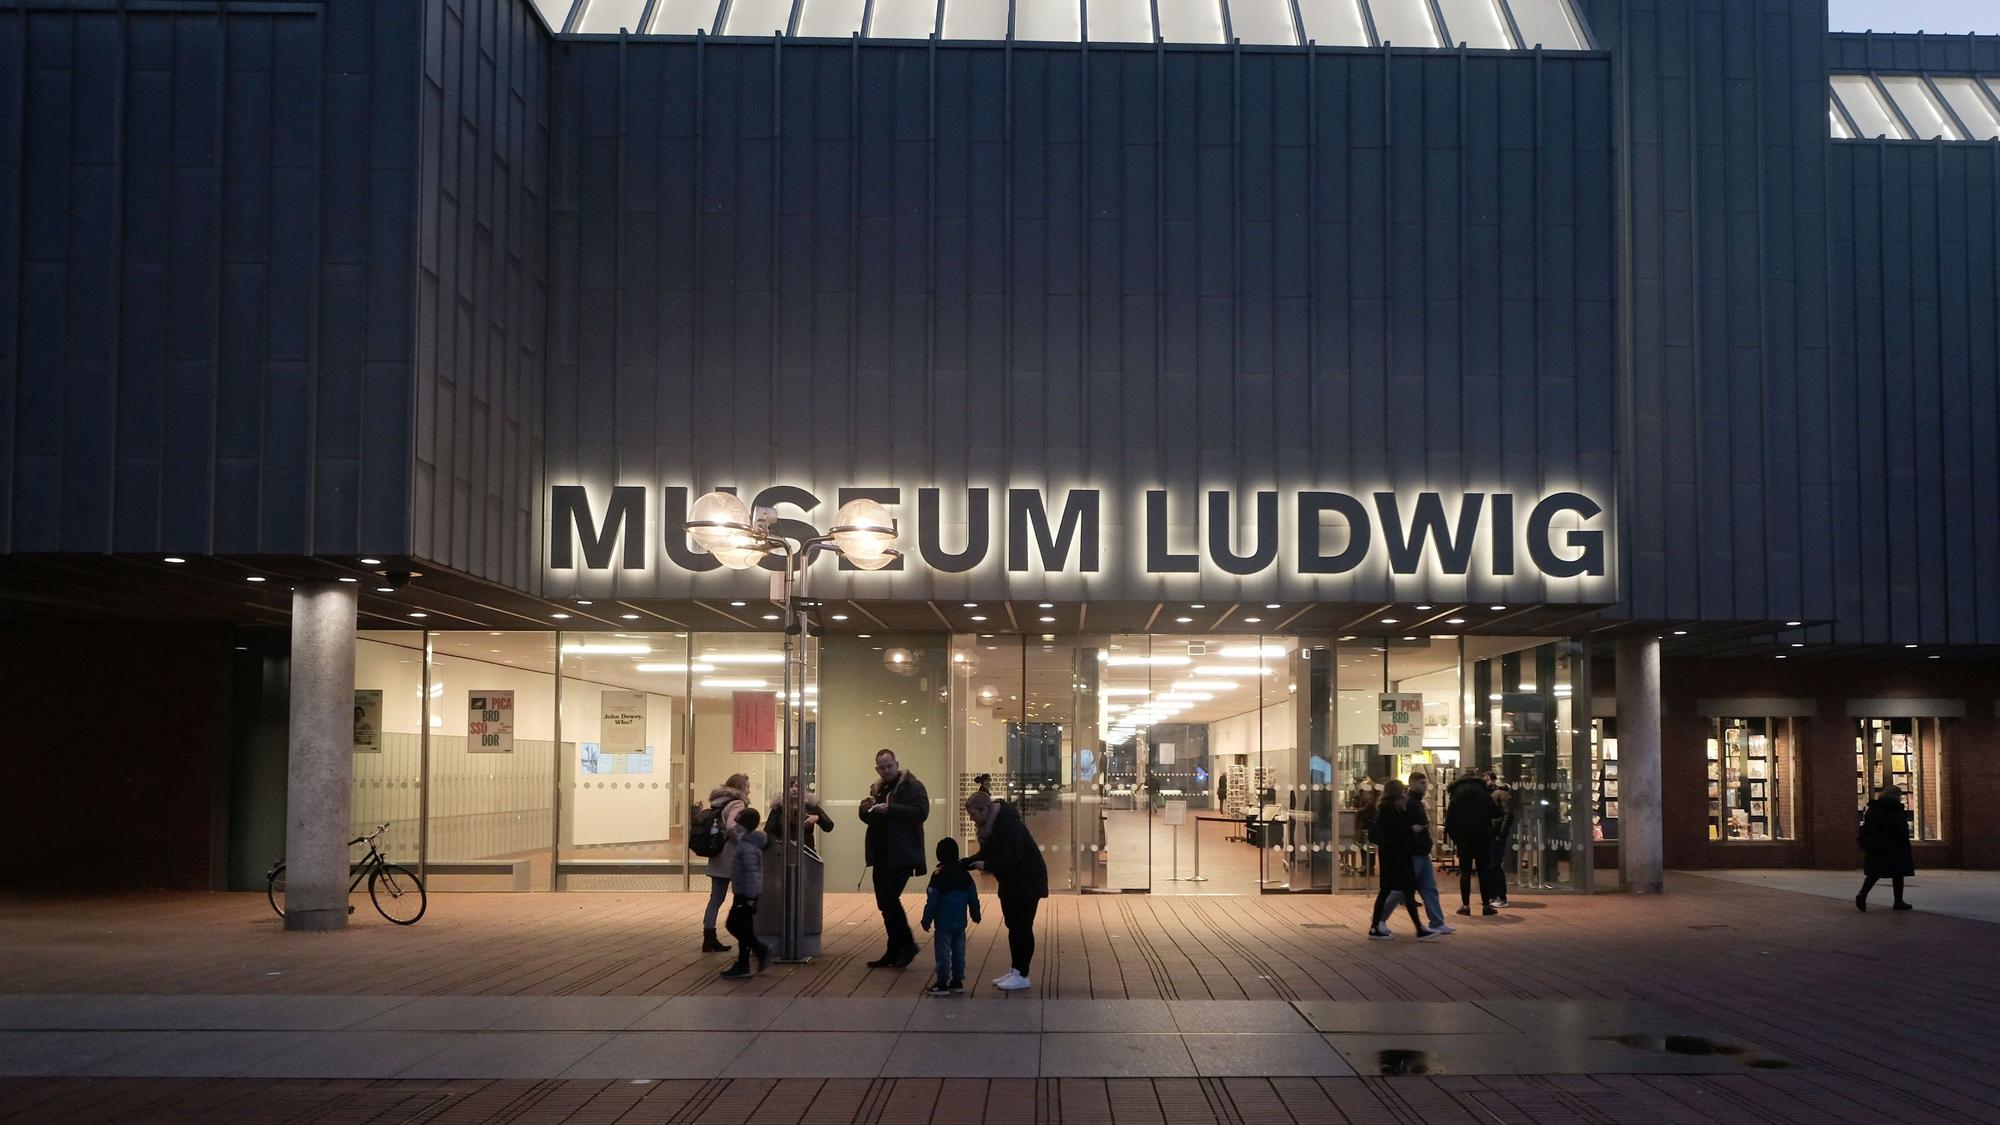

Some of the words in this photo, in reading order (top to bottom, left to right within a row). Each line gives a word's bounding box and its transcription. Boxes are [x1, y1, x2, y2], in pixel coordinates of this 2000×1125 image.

[551, 484, 1100, 573] MUSEUM
[1146, 490, 1606, 578] LUDWIG
[491, 697, 512, 710] PICA
[1401, 699, 1420, 712] PICA
[482, 710, 500, 722] BRD
[1392, 712, 1409, 723] BRD
[470, 722, 487, 735] SSO
[1381, 724, 1397, 736] SSO
[481, 734, 500, 747] DDR
[1392, 736, 1409, 748] DDR
